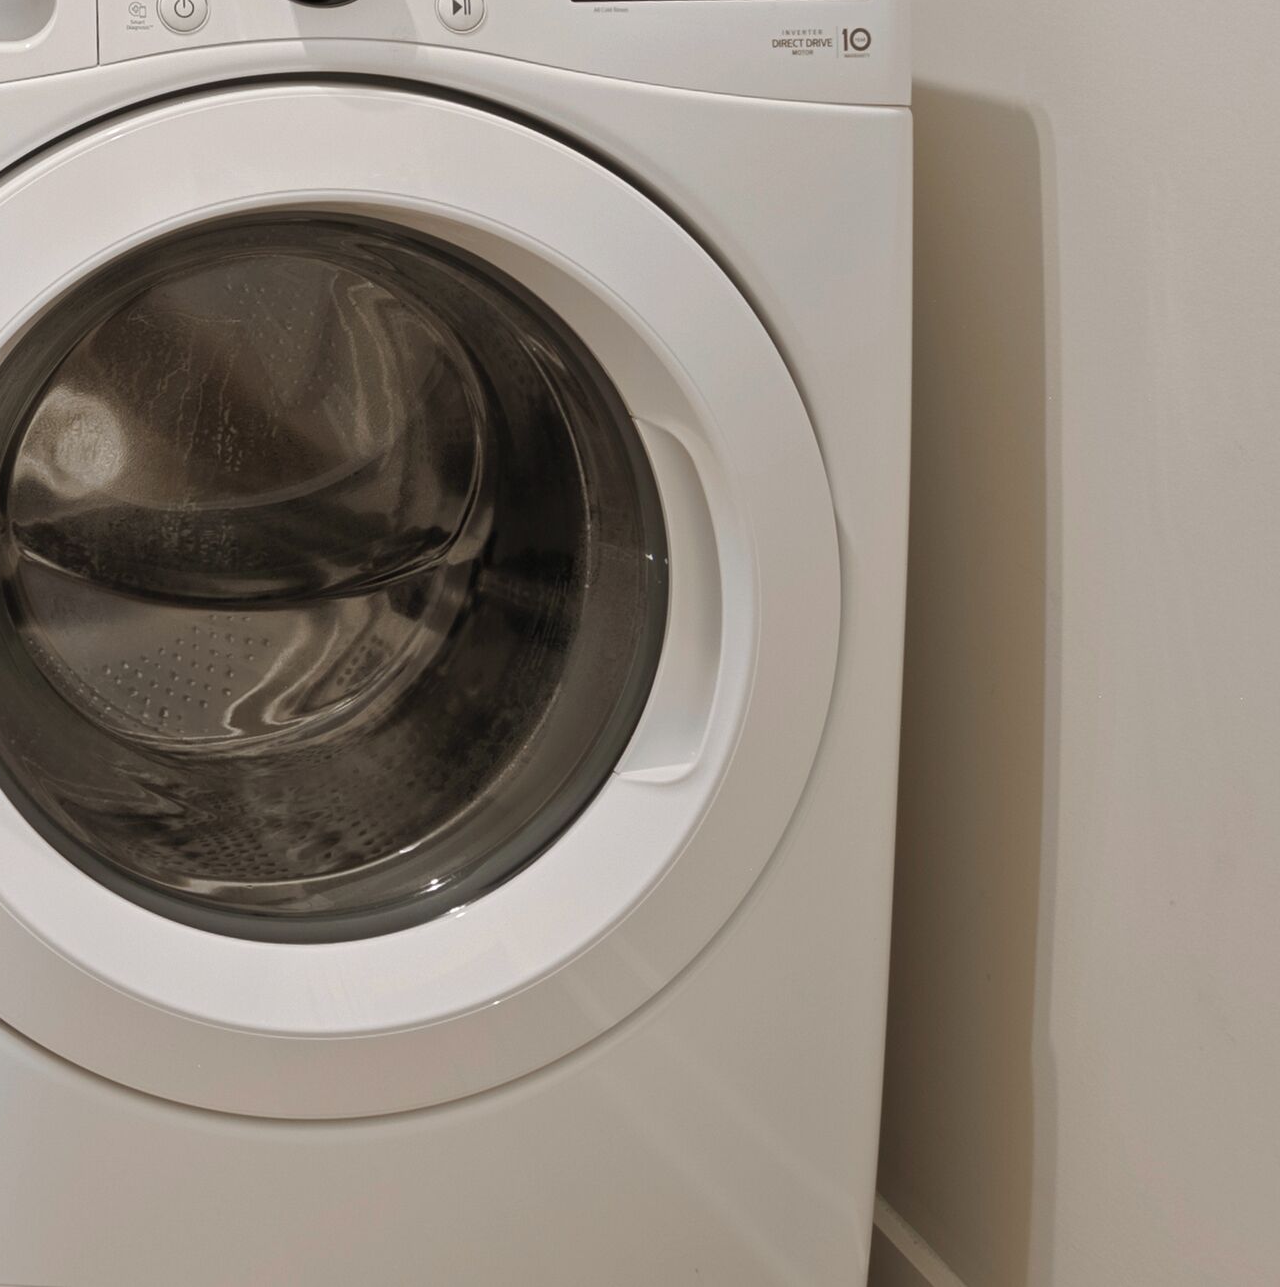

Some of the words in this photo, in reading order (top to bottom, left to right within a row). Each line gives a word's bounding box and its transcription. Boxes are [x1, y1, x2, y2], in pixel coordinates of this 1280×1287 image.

[772, 38, 804, 48] DIRECT
[806, 38, 833, 48] DRIVE
[842, 27, 872, 52] 10
